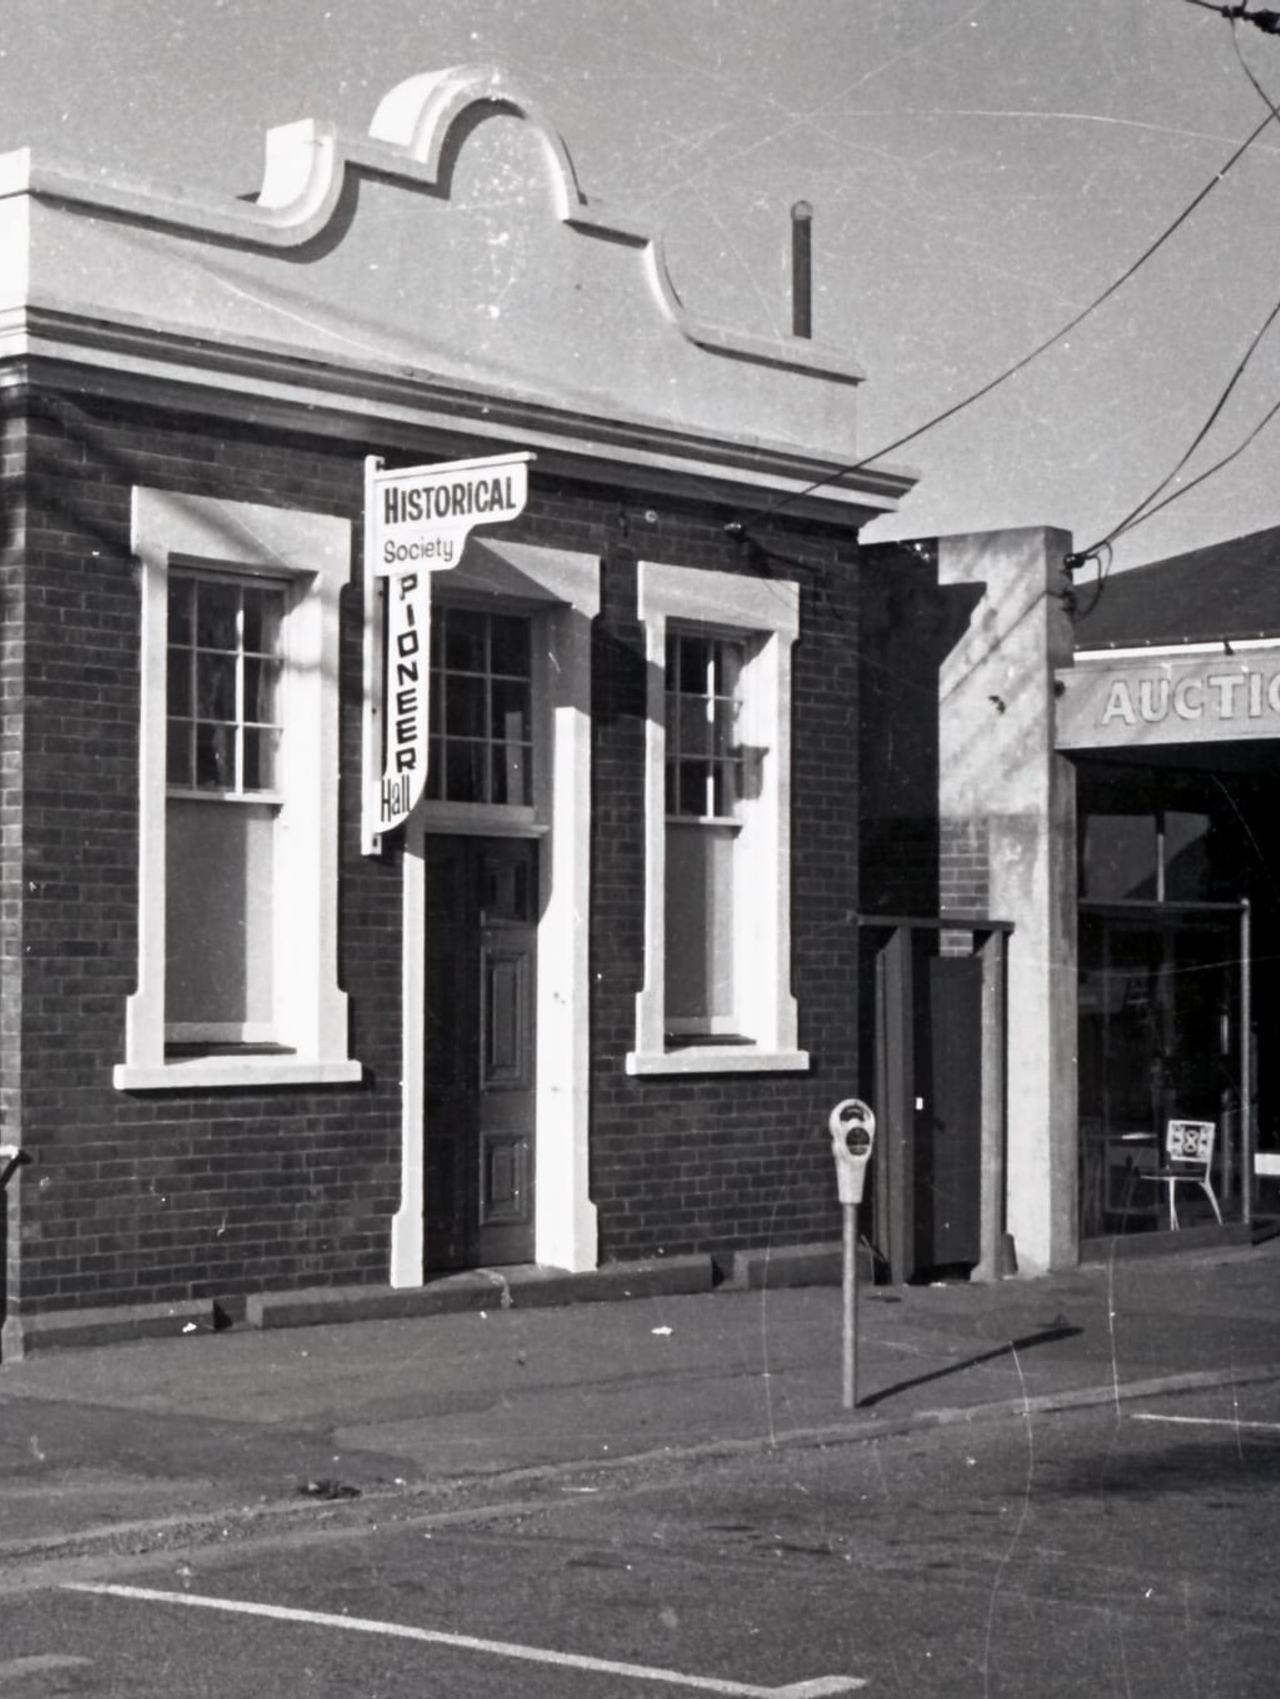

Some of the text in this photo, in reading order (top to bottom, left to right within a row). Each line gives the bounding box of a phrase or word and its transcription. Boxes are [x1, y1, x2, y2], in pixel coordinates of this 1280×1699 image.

[383, 535, 454, 564] Society
[396, 573, 419, 775] PIONEER
[381, 774, 410, 822] Hall
